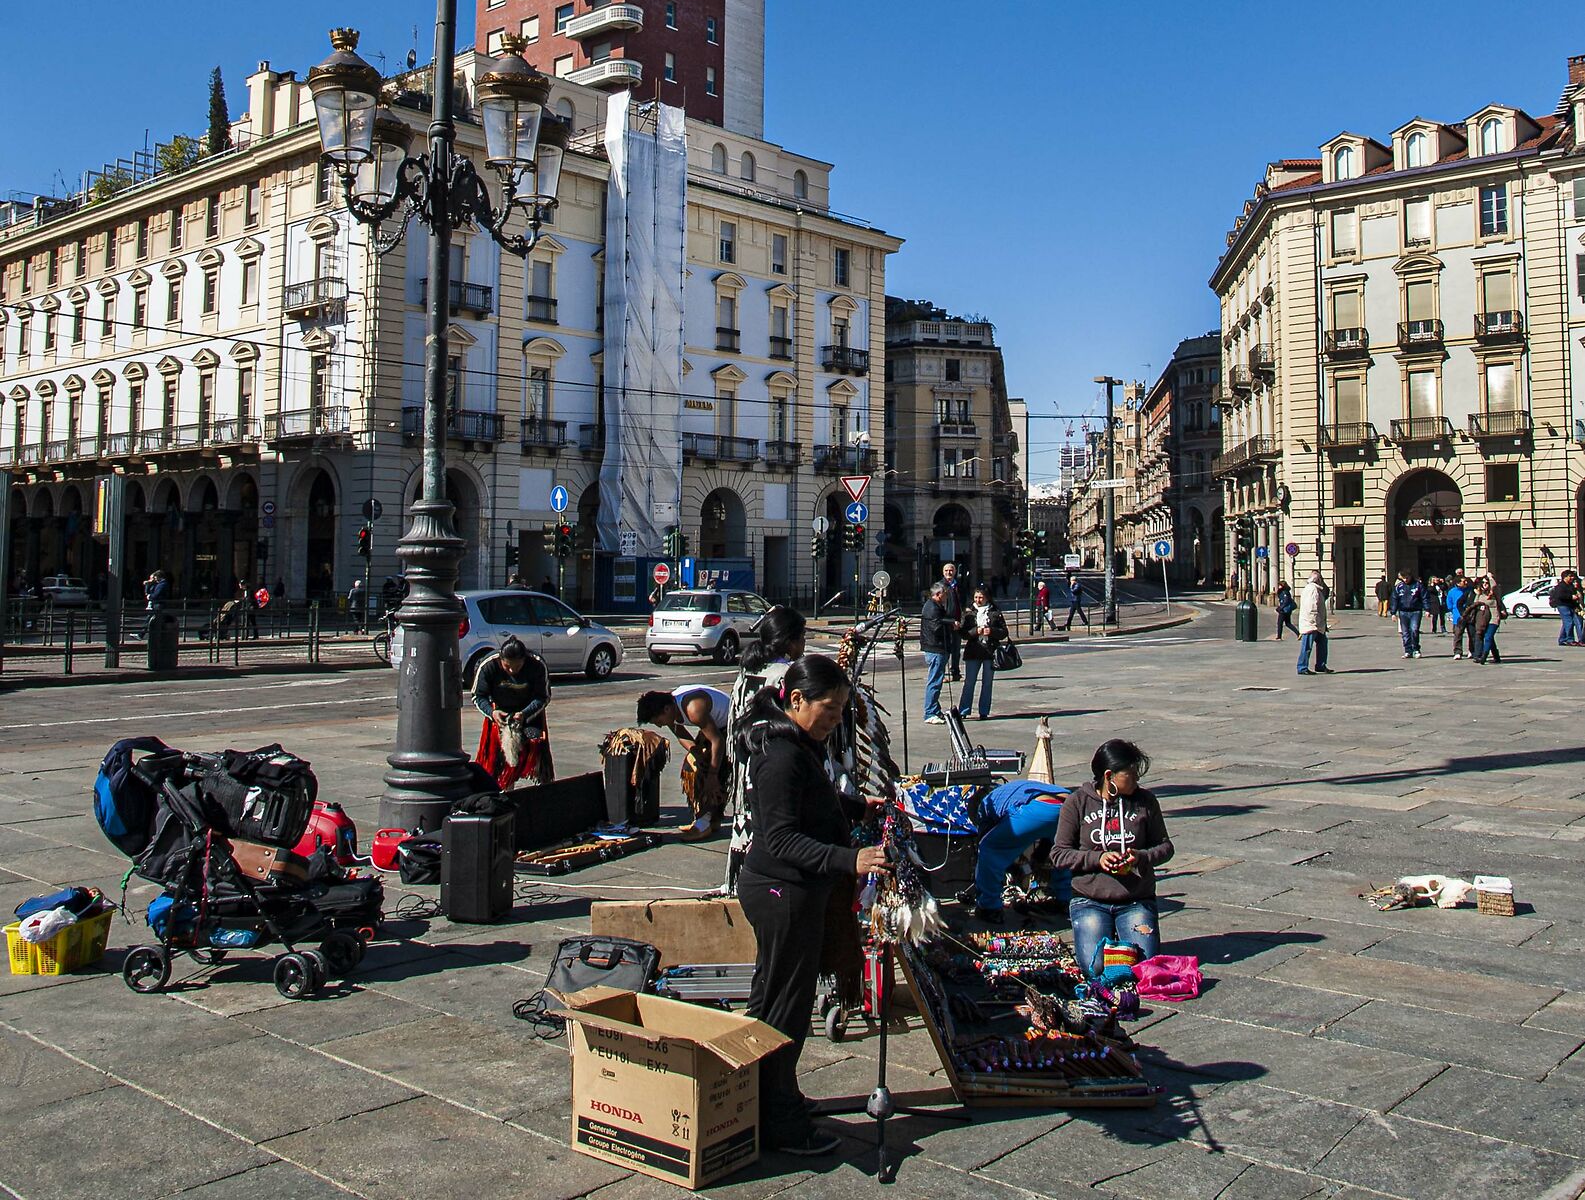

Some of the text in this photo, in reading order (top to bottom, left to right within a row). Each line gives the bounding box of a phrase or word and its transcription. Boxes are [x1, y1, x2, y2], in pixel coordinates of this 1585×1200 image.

[646, 1039, 669, 1055] EX6
[646, 1058, 669, 1075] EX7
[590, 1099, 644, 1125] HONDA
[588, 1121, 618, 1137] Generator
[706, 1117, 739, 1137] HONDA
[588, 1135, 610, 1150] Groupe
